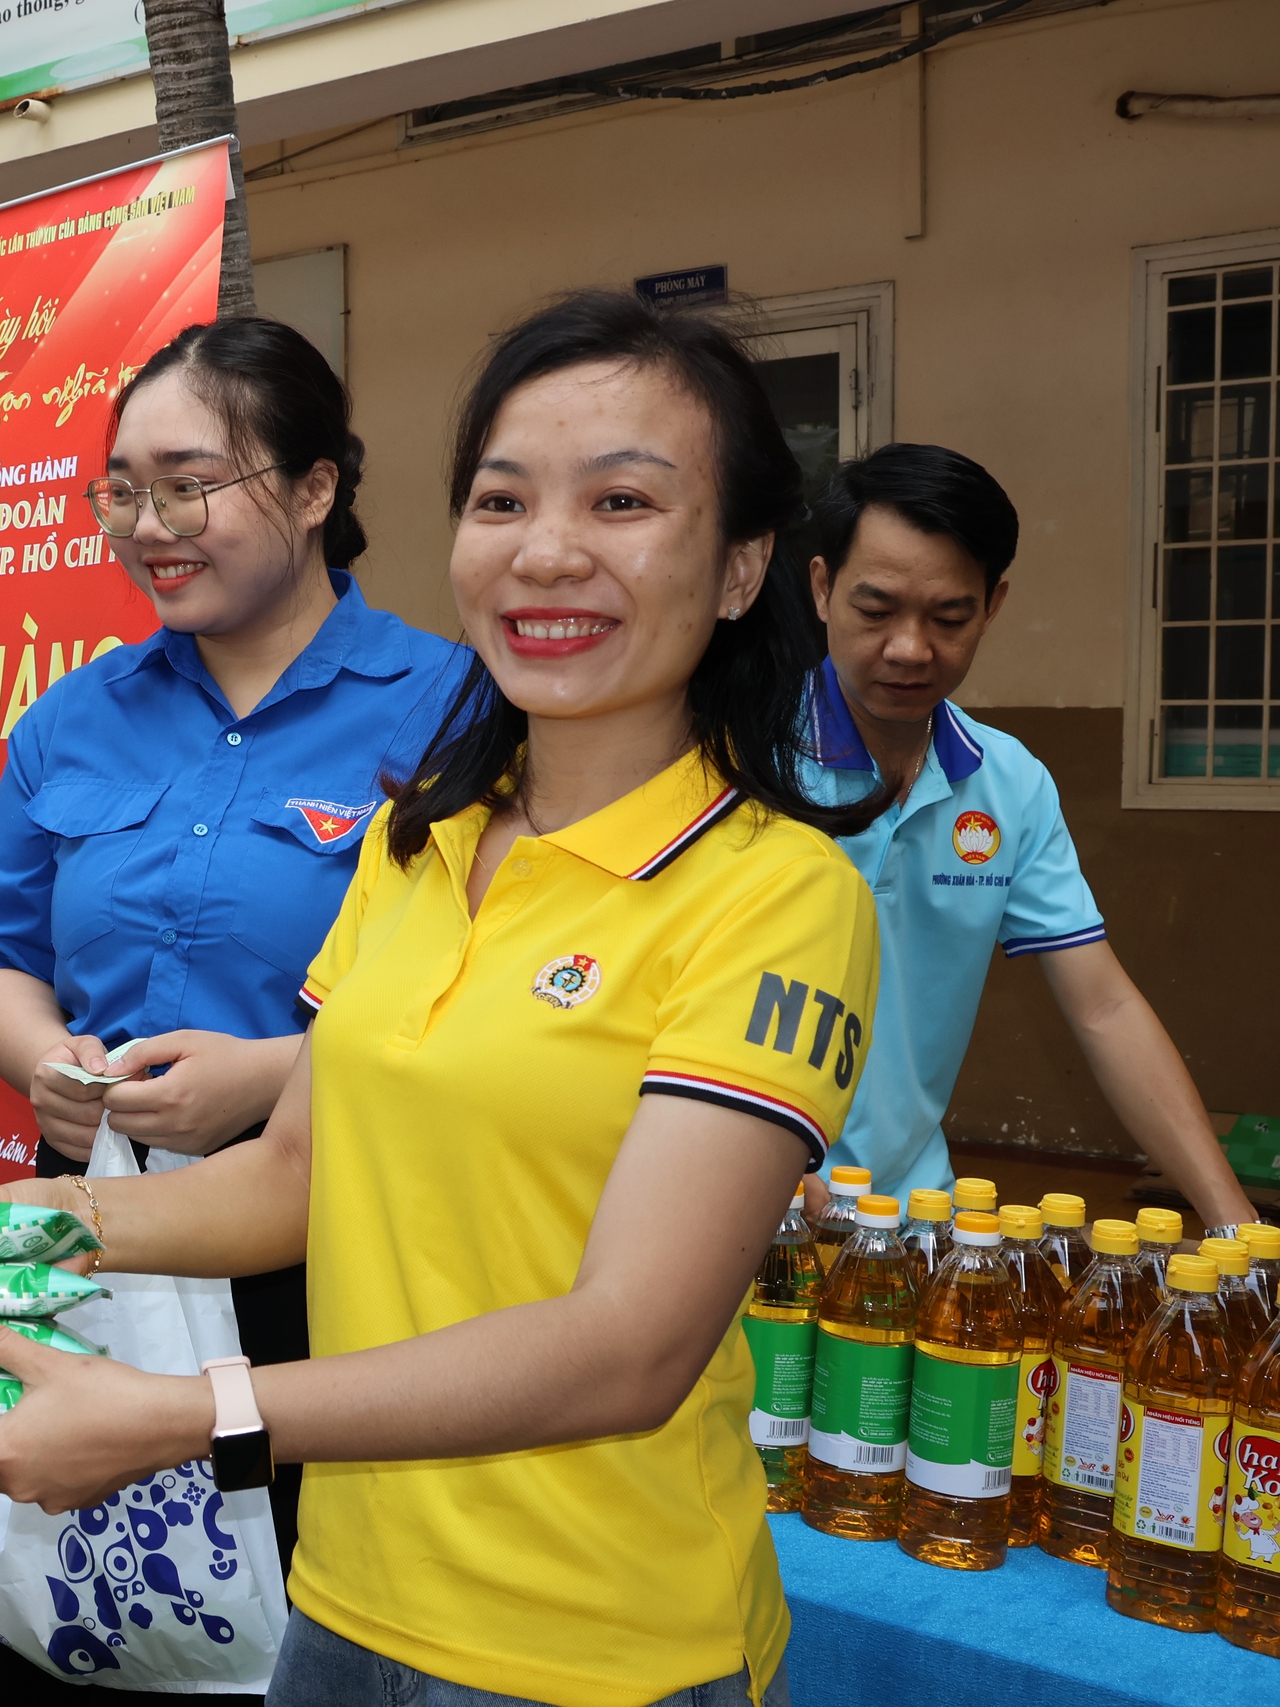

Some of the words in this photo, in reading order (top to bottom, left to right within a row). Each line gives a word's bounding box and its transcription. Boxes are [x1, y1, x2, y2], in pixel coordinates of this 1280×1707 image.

[7, 232, 24, 255] LẦN
[25, 226, 43, 250] THỨ
[42, 225, 57, 245] XIV
[58, 216, 75, 241] CỦA
[77, 210, 102, 235] ĐẢNG
[103, 206, 128, 231] CỘNG
[129, 196, 150, 220] SẢN
[150, 191, 170, 216] VIỆT
[171, 185, 196, 208] NAM
[654, 277, 685, 294] PHÒNG
[686, 273, 707, 290] MÁY
[22, 295, 61, 347] hội
[42, 362, 109, 428] nghĩa
[29, 455, 78, 484] HÀNH
[21, 531, 58, 574] HỒ
[64, 528, 105, 569] CHÍ
[290, 800, 319, 809] THANH
[319, 804, 338, 814] NIÊN
[339, 808, 357, 819] VIỆT
[745, 971, 862, 1090] NTS
[1162, 1413, 1175, 1421] HIỆU
[1243, 1443, 1280, 1472] ha
